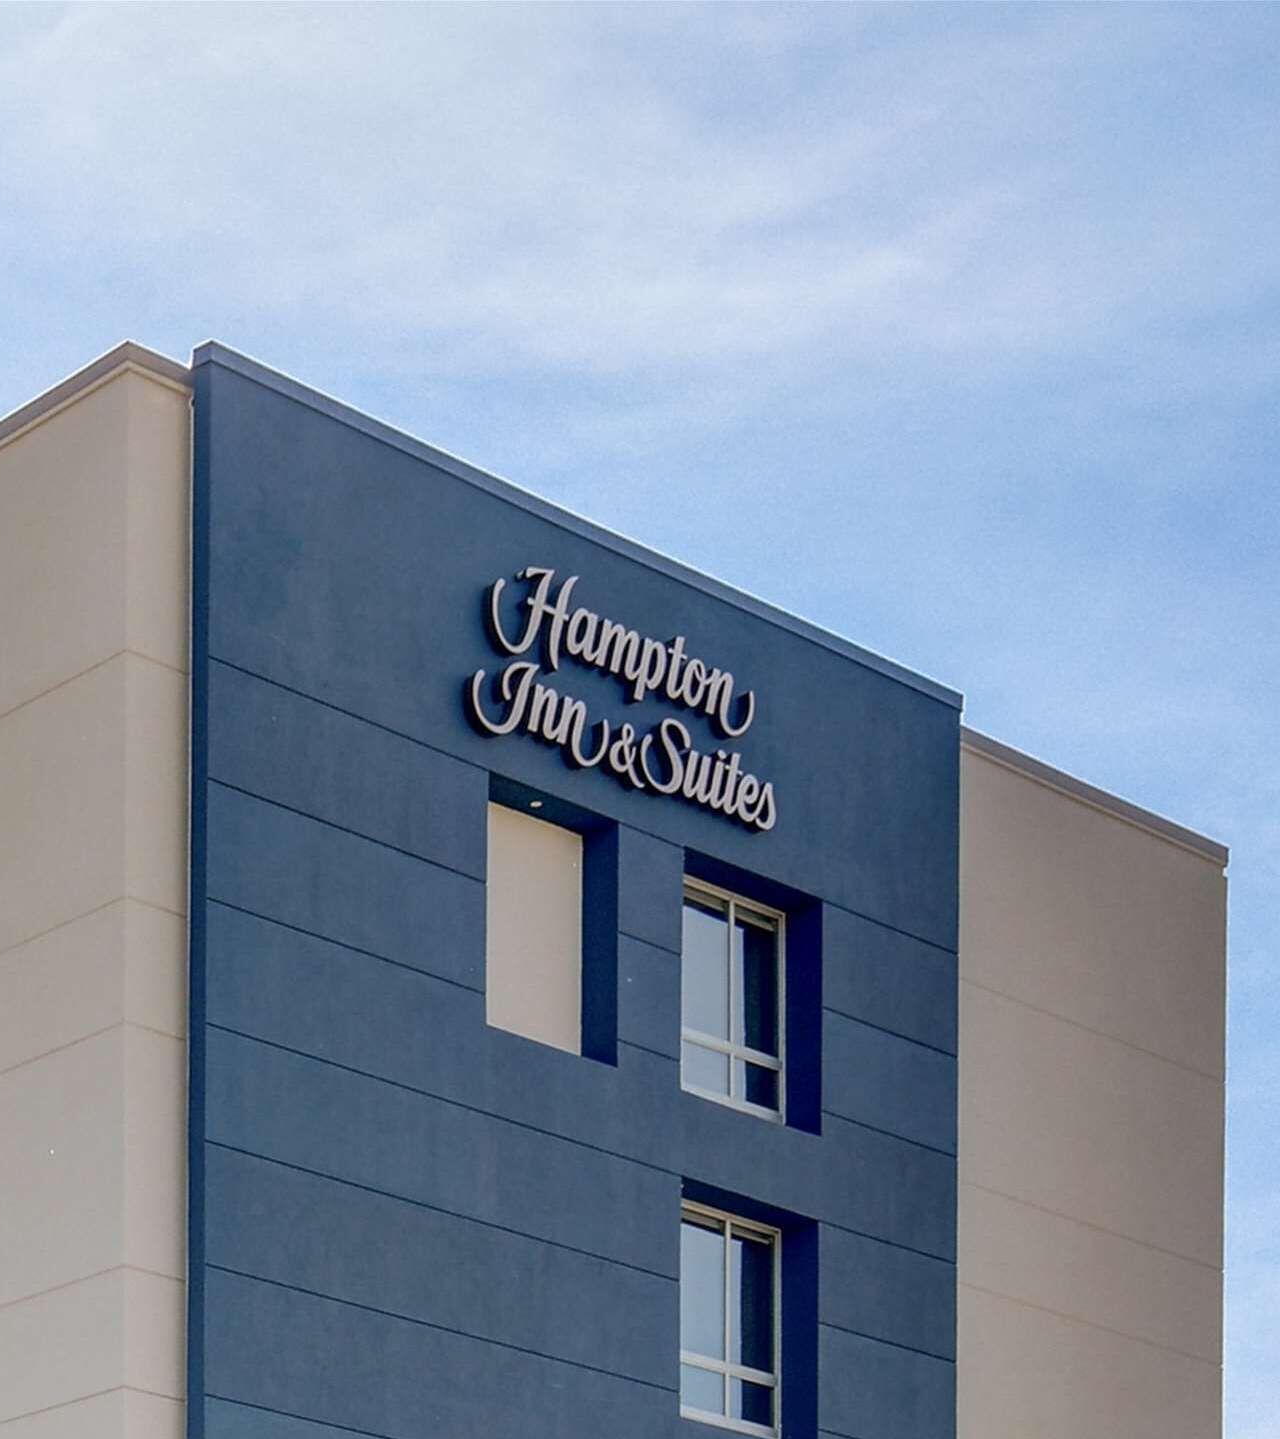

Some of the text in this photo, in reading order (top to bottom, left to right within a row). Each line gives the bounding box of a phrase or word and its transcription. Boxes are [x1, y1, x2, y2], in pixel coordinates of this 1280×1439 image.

[492, 566, 755, 738] Hampton
[472, 661, 778, 831] Inn & Suites
